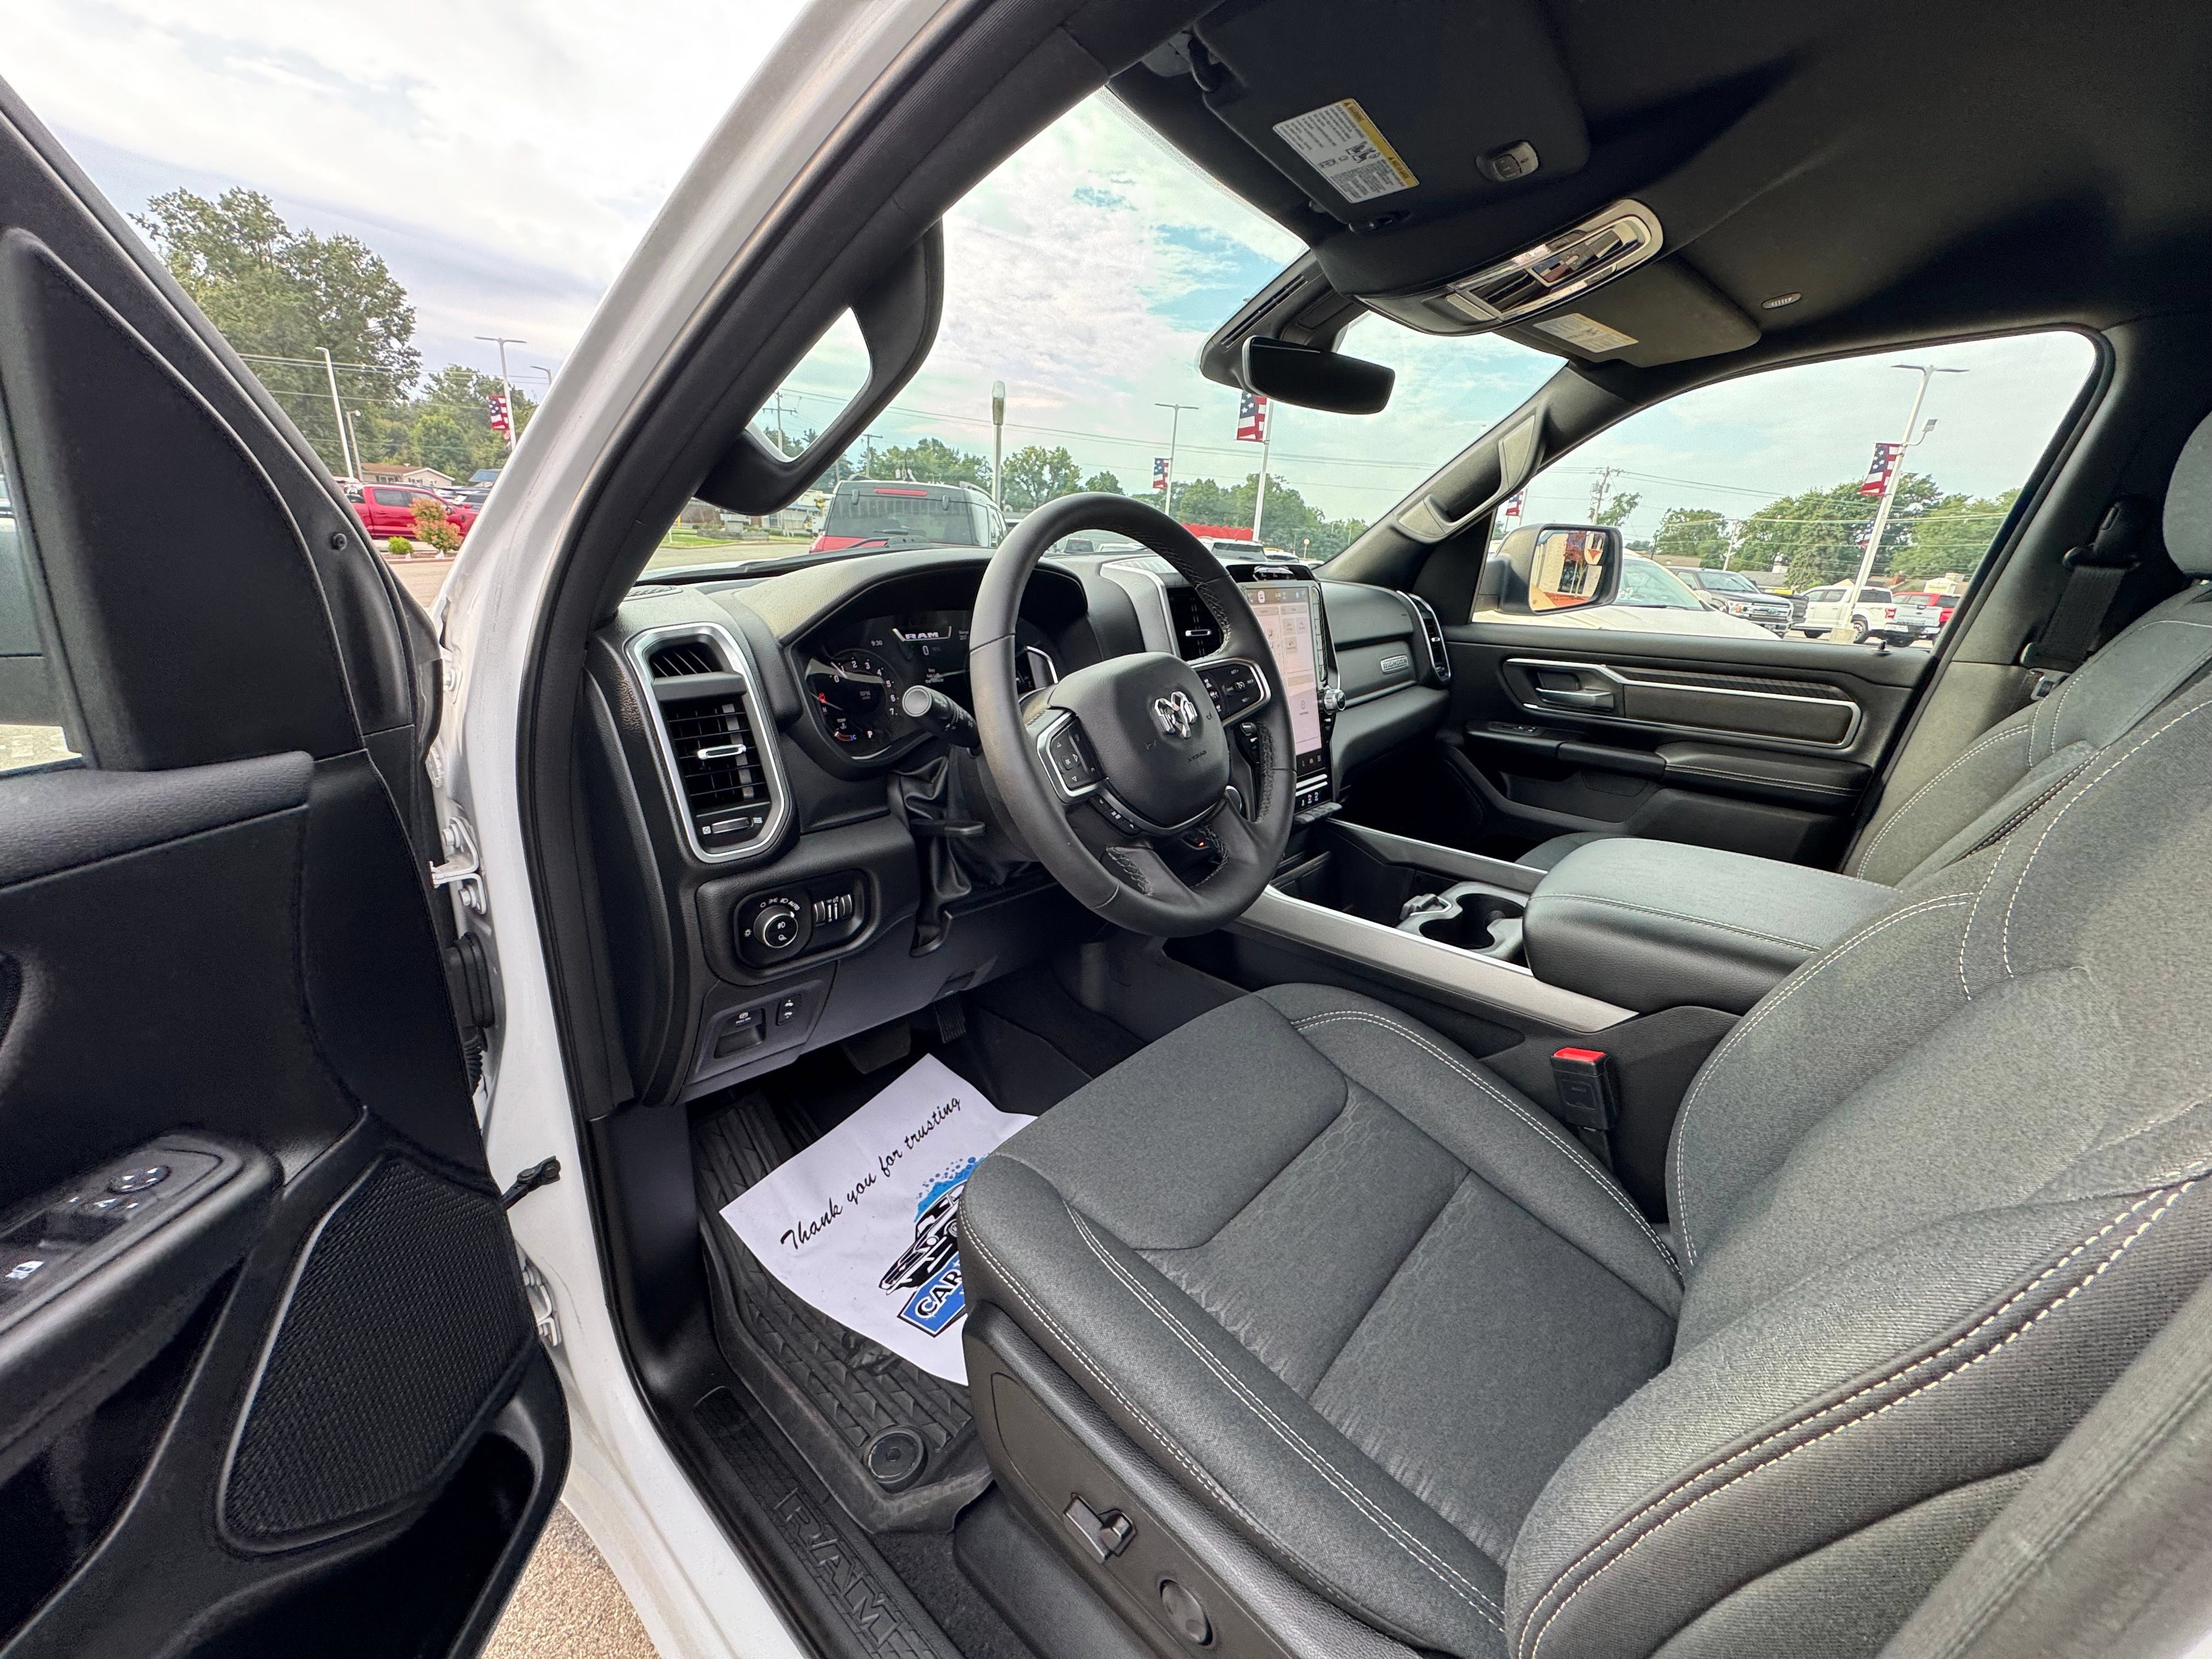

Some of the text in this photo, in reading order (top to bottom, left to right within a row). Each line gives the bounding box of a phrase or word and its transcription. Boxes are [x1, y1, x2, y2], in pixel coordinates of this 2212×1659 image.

[851, 661, 857, 669] 2
[865, 662, 871, 670] 3
[886, 680, 891, 688] 5
[788, 901, 800, 911] AUTO
[780, 1096, 961, 1251] Thank you for trusting
[774, 1487, 901, 1647] RAM
